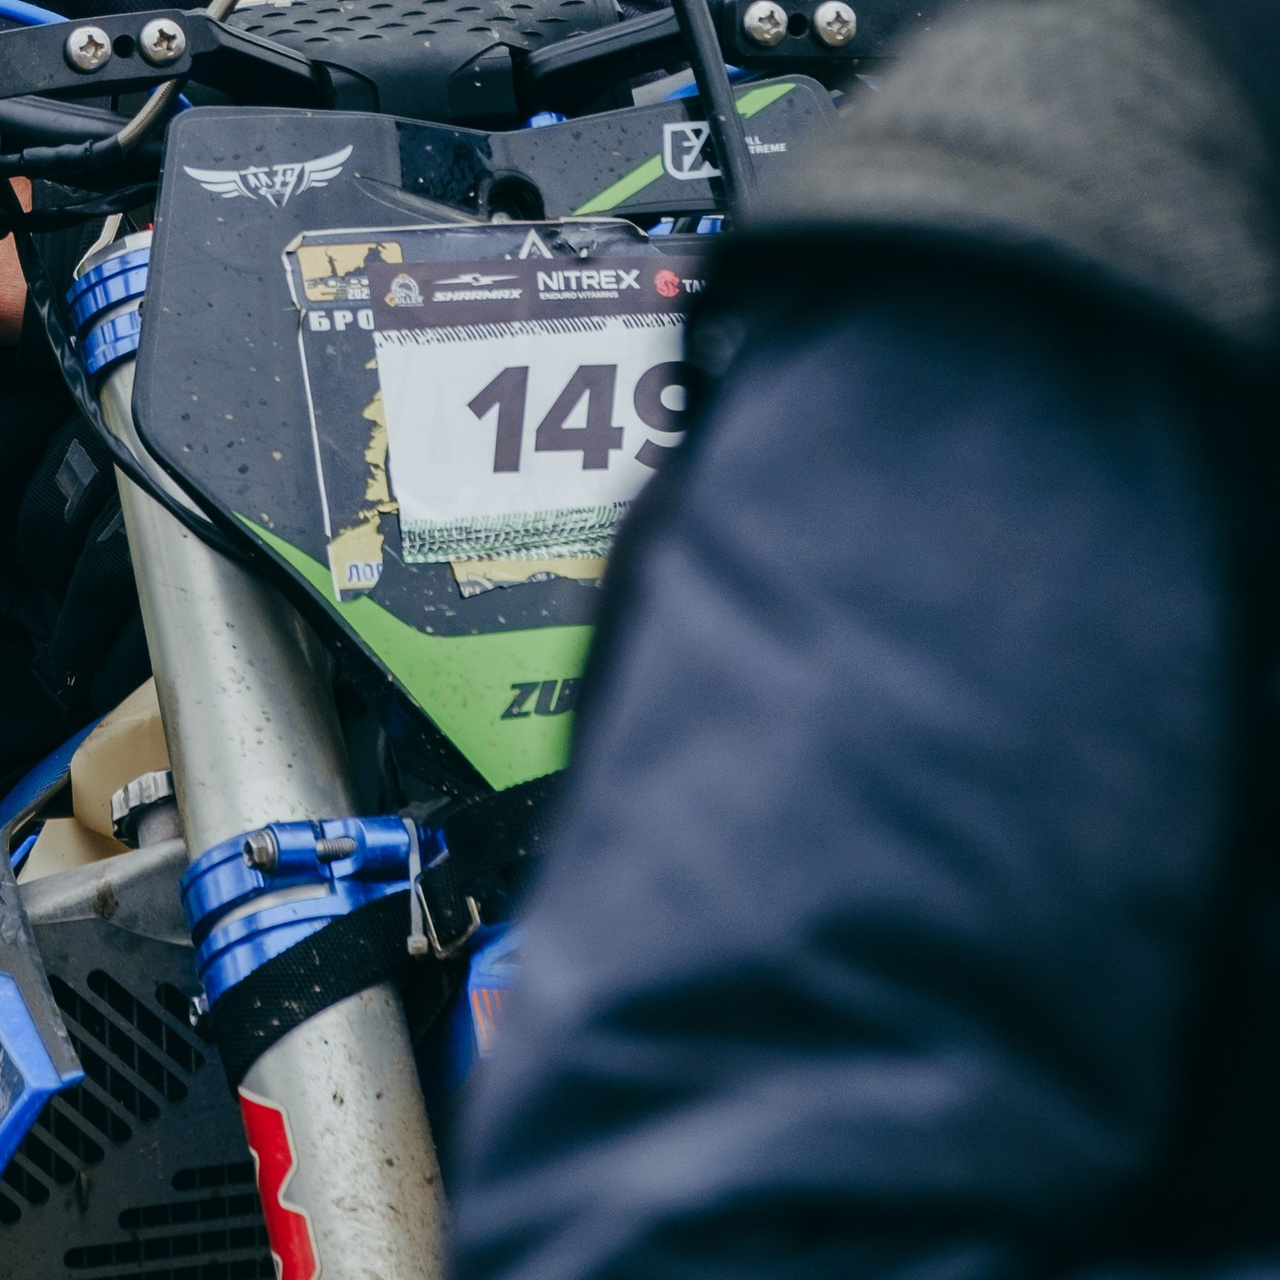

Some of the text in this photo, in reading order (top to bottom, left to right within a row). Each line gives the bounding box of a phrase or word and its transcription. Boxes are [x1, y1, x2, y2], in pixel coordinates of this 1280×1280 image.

[747, 142, 787, 155] TREME
[536, 268, 642, 291] NITREX
[432, 288, 524, 302] SHARMAX
[538, 289, 620, 301] ENDURO VITAMINS
